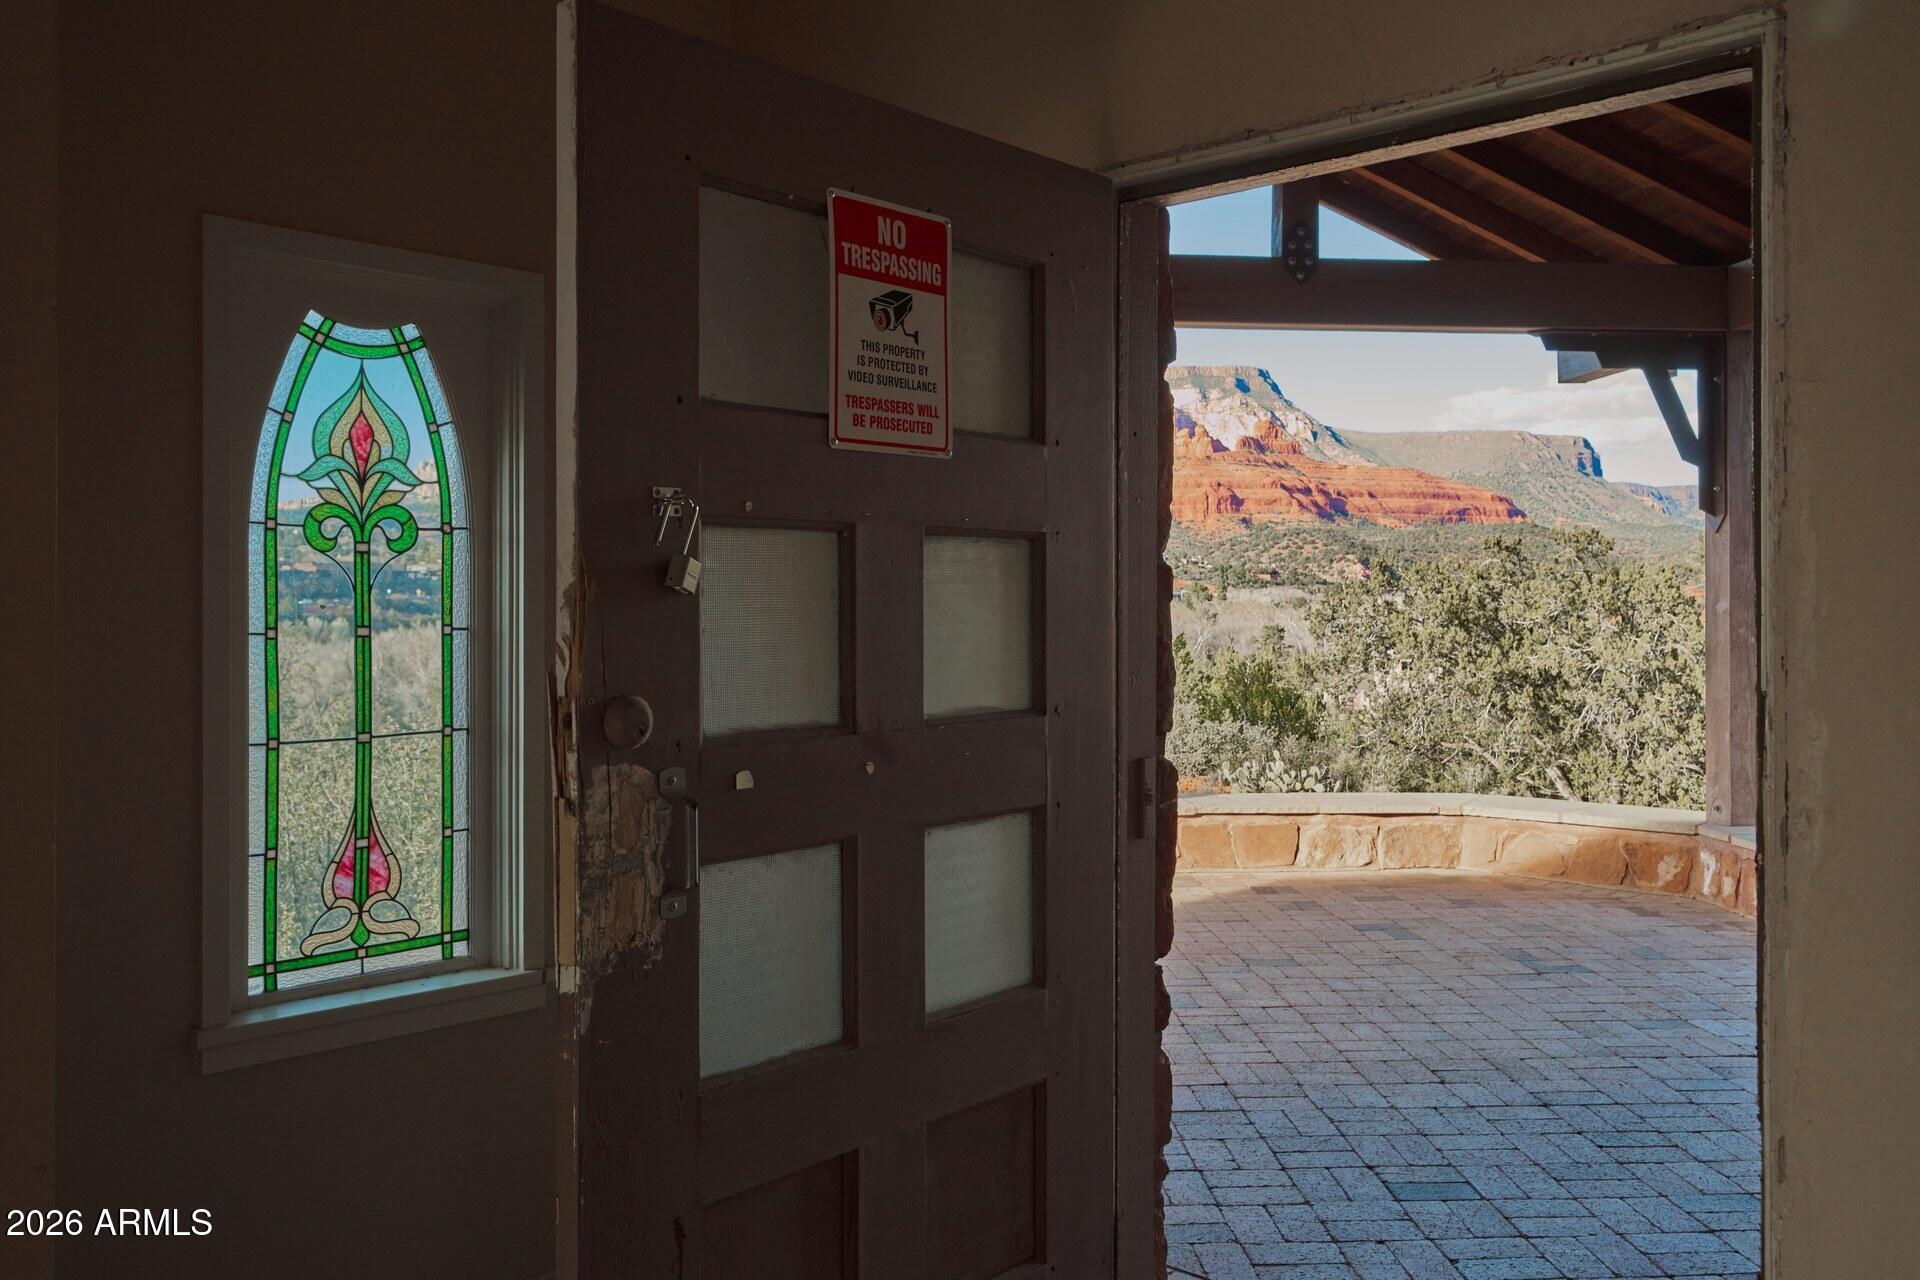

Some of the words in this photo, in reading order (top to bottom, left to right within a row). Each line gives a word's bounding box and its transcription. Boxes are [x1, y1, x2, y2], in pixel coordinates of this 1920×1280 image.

[878, 216, 906, 250] NO
[841, 241, 942, 287] TRESPASSING
[861, 340, 880, 353] THIS
[883, 344, 926, 360] PROPERTY
[857, 355, 866, 366] IS
[869, 357, 916, 374] PROTECTED
[919, 365, 929, 377] BY
[848, 369, 874, 384] VIDEO
[877, 374, 937, 393] SURVEILLANCE
[845, 394, 914, 416] TRESPASSERS
[917, 404, 940, 419] WILL
[853, 413, 866, 428] BE
[870, 415, 933, 435] PROSECUTED
